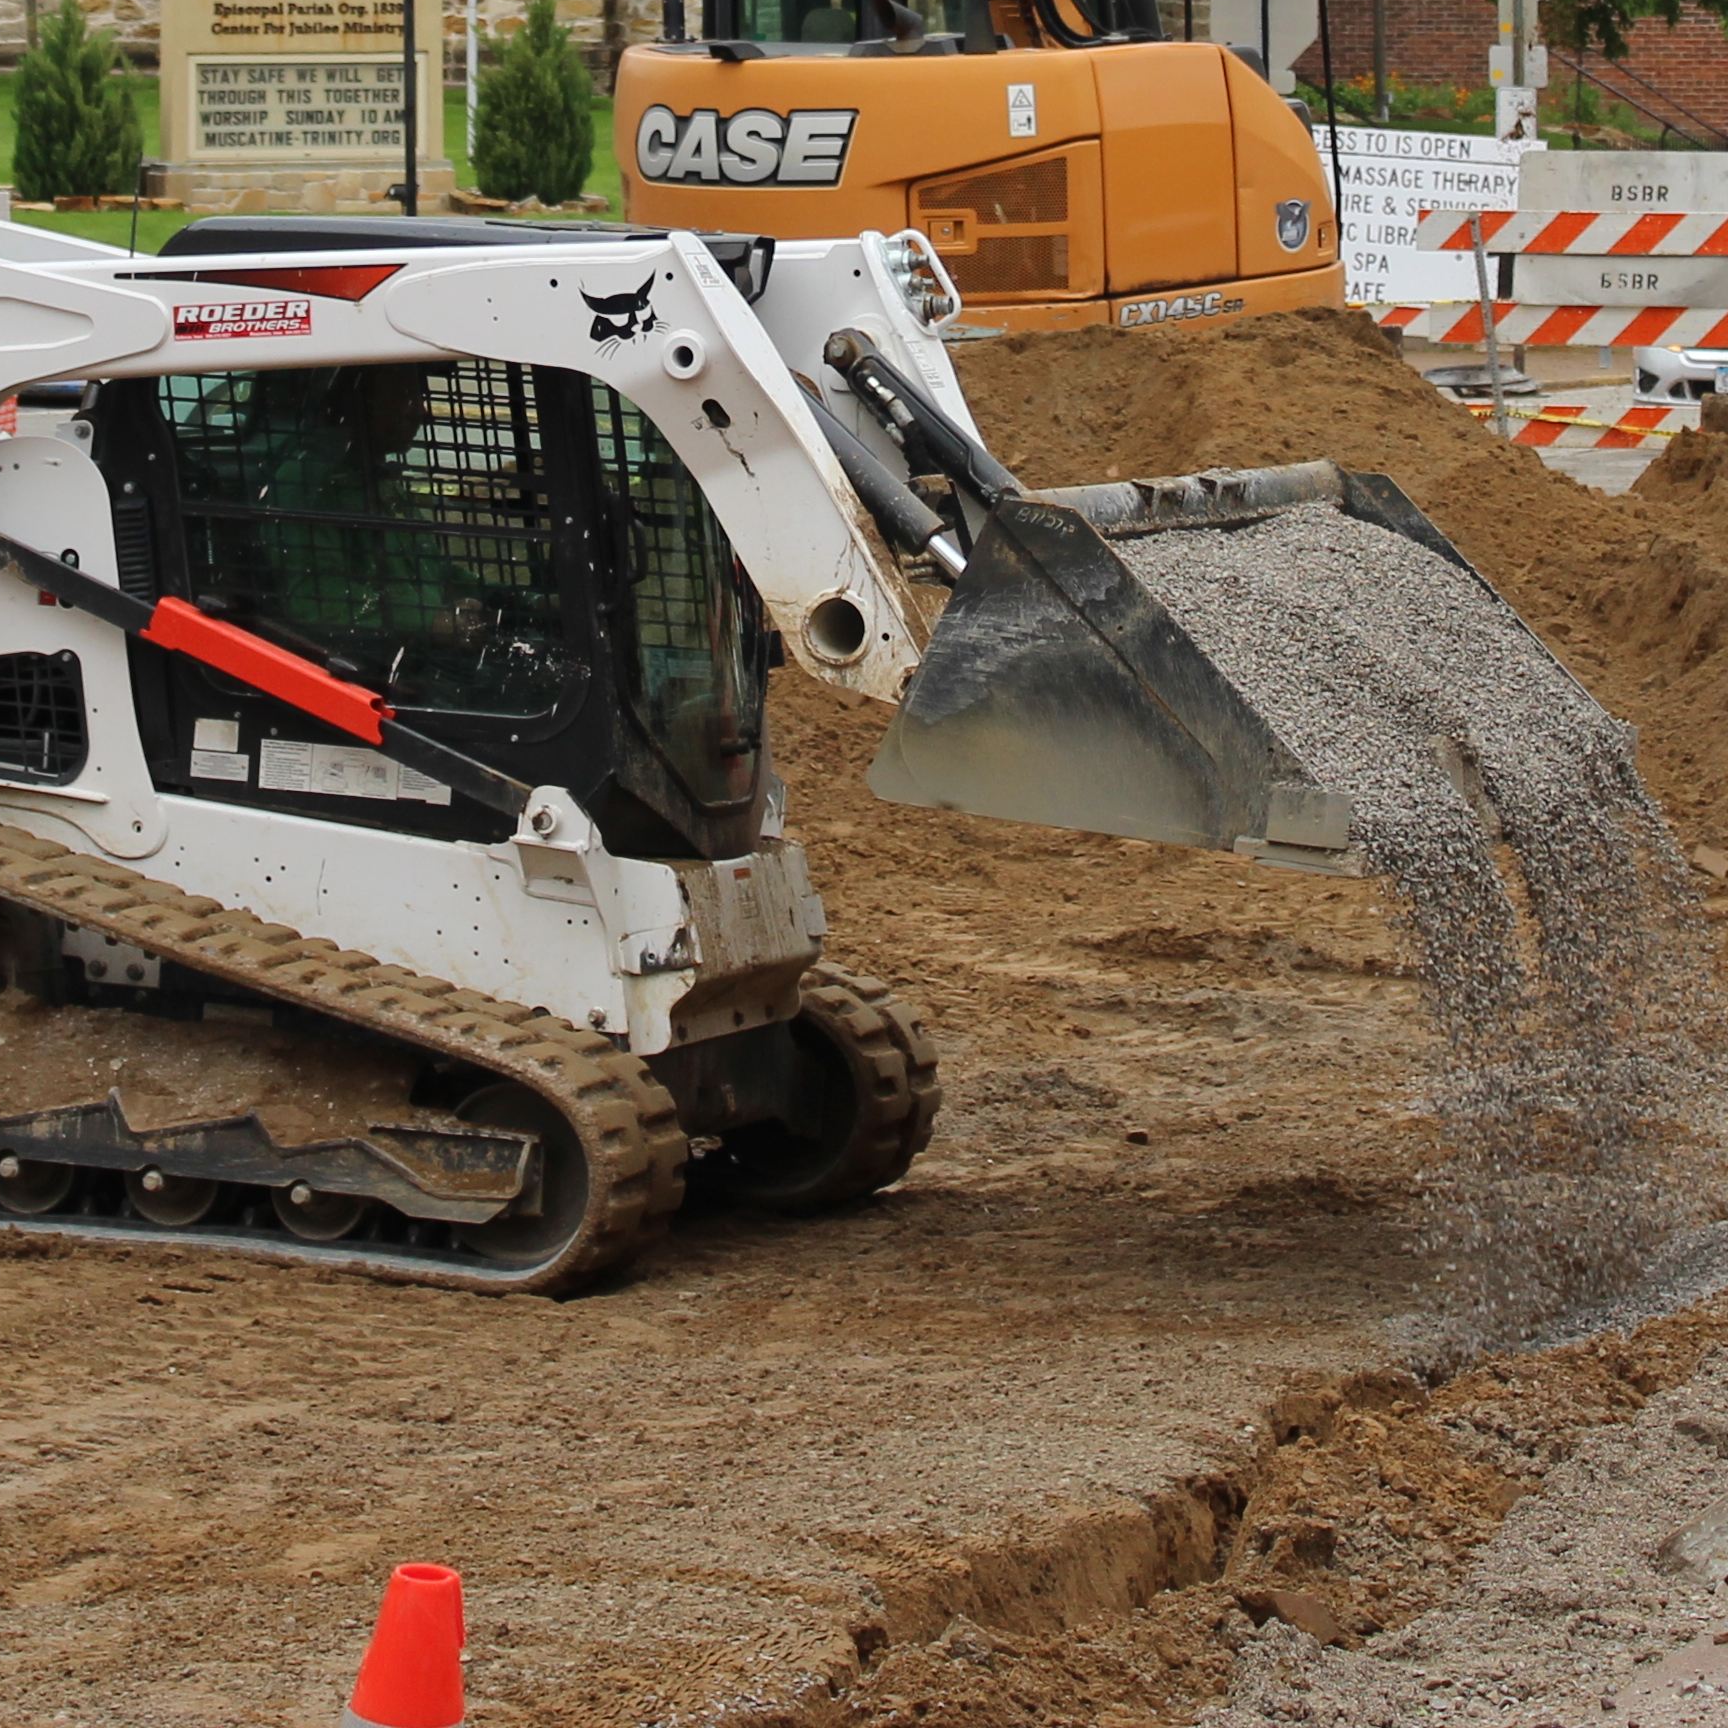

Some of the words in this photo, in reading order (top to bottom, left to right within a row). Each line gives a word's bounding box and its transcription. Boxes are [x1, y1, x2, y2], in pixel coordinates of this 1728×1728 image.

[214, 3, 284, 18] Episcopal
[288, 3, 334, 15] Parish
[338, 2, 368, 18] Org.
[212, 23, 260, 35] Center
[264, 23, 285, 35] For
[289, 22, 339, 37] Jubilee
[343, 22, 405, 38] Ministry
[201, 69, 240, 84] STAY
[247, 68, 285, 83] SAFE
[296, 68, 317, 83] WE
[325, 68, 362, 83] WILL
[377, 67, 404, 83] GET
[198, 90, 266, 105] THROUGH
[277, 89, 312, 104] THIS
[324, 88, 400, 104] TOGETHER
[200, 111, 268, 126] WORSHIP
[286, 110, 345, 125] SUNDAY
[361, 109, 378, 125] 10
[383, 109, 405, 124] AM
[204, 130, 400, 147] MUSCATINE-TRINITY.ORG
[636, 104, 859, 184] CASE
[1311, 130, 1357, 151] CESS
[1365, 133, 1388, 155] TO
[1395, 135, 1413, 156] IS
[1420, 137, 1472, 159] OPEN
[1339, 165, 1424, 190] MASSAGE
[1433, 171, 1517, 196] THERAPY
[1611, 185, 1669, 202] BSBR
[1341, 193, 1373, 215] IRE
[1381, 196, 1398, 216] &
[1366, 223, 1417, 247] LIBRA
[1352, 253, 1390, 274] SPA
[176, 301, 309, 324] ROEDER
[1120, 292, 1222, 328] CX145C
[209, 319, 302, 333] BROTHERS
